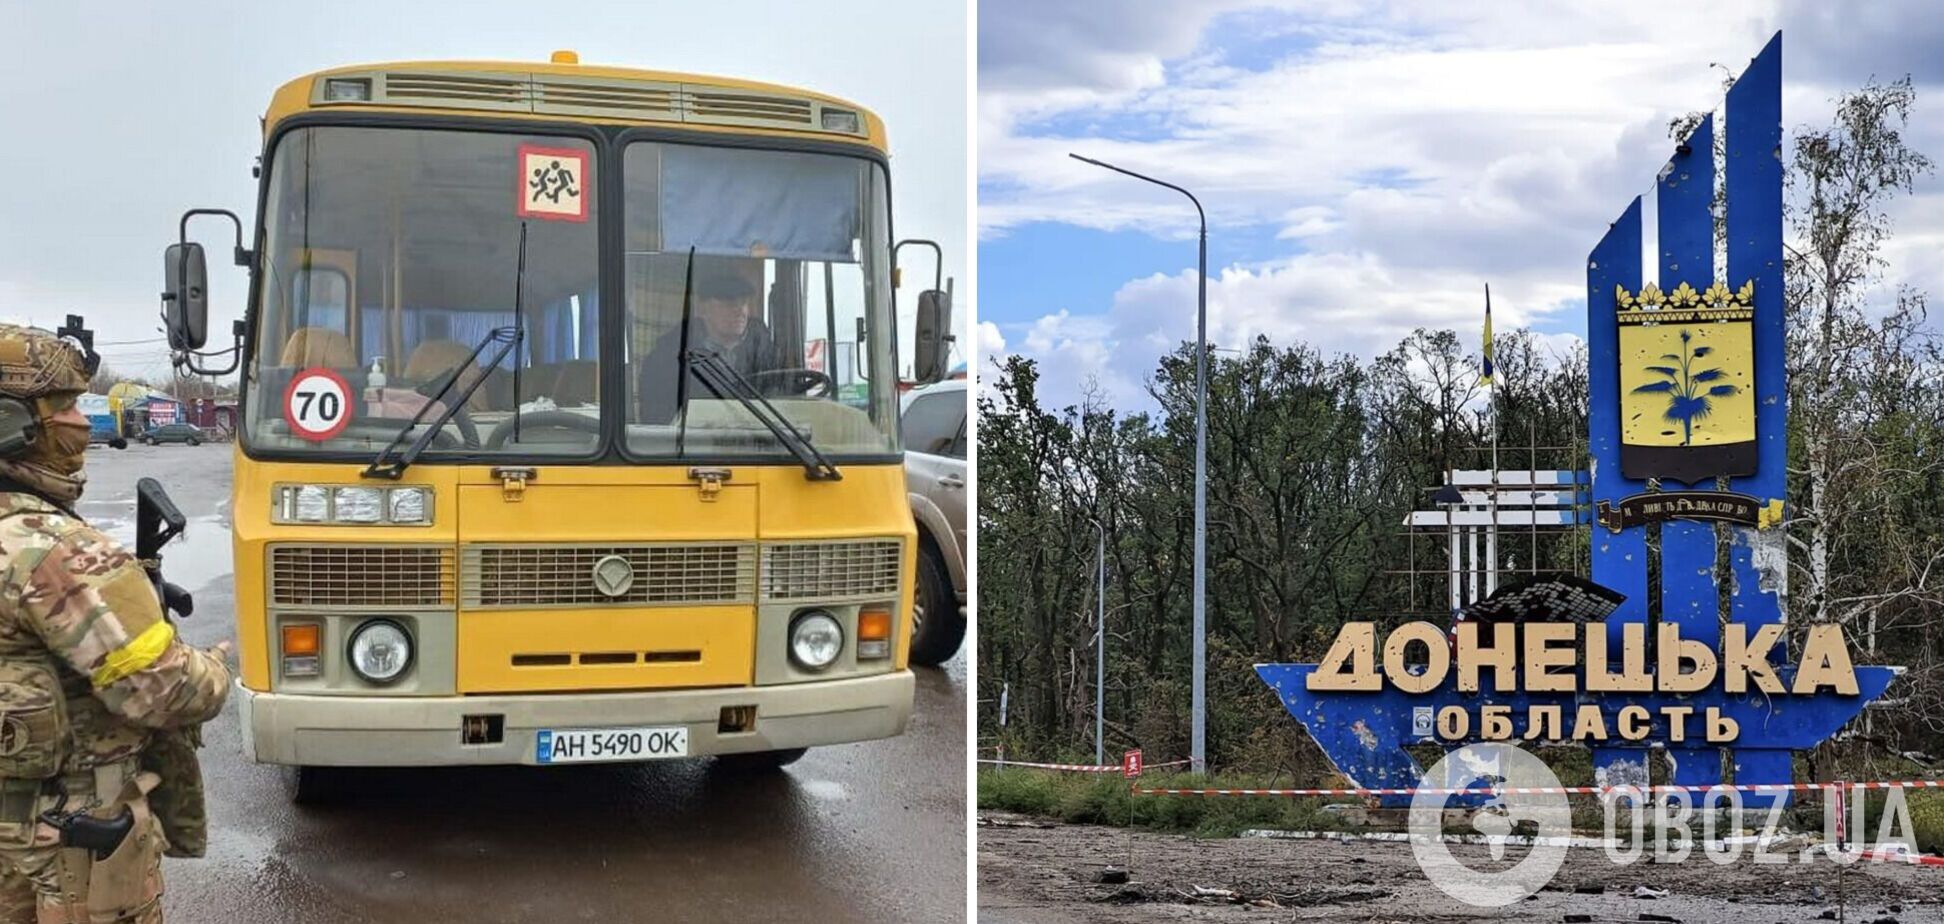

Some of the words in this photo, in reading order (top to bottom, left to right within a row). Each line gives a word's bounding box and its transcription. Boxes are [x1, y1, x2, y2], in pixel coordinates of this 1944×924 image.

[296, 391, 339, 421] 70
[1306, 621, 1860, 695] ДОНЕЦЬКА
[1437, 705, 1740, 742] ОБЛАСТЬ
[552, 735, 585, 757] AH
[591, 733, 642, 756] 5490
[648, 731, 680, 754] OK
